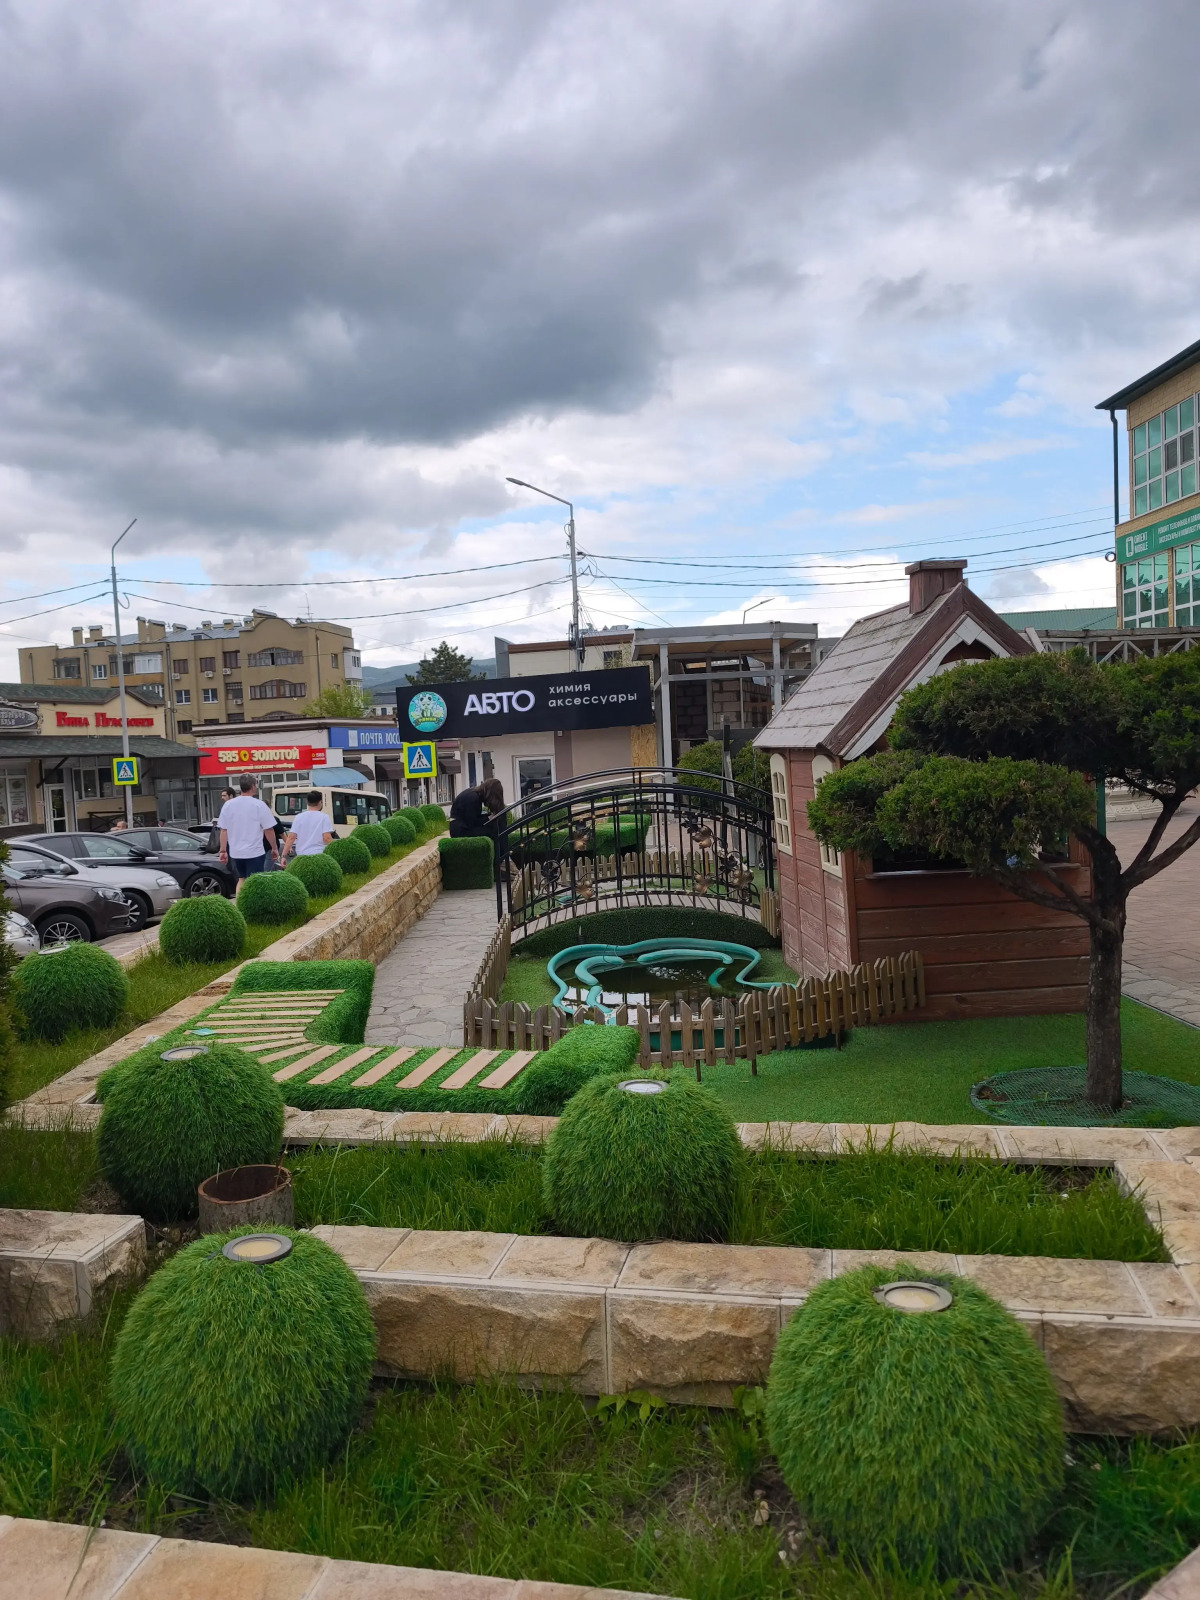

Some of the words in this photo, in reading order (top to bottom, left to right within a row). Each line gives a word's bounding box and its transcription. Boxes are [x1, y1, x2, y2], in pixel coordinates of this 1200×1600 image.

[549, 683, 591, 694] химия
[464, 690, 536, 716] АВТО
[548, 693, 637, 708] аксессуары
[360, 732, 383, 745] ПОЧТА
[218, 750, 239, 763] 585
[250, 747, 300, 762] ЗОЛОТОЙ
